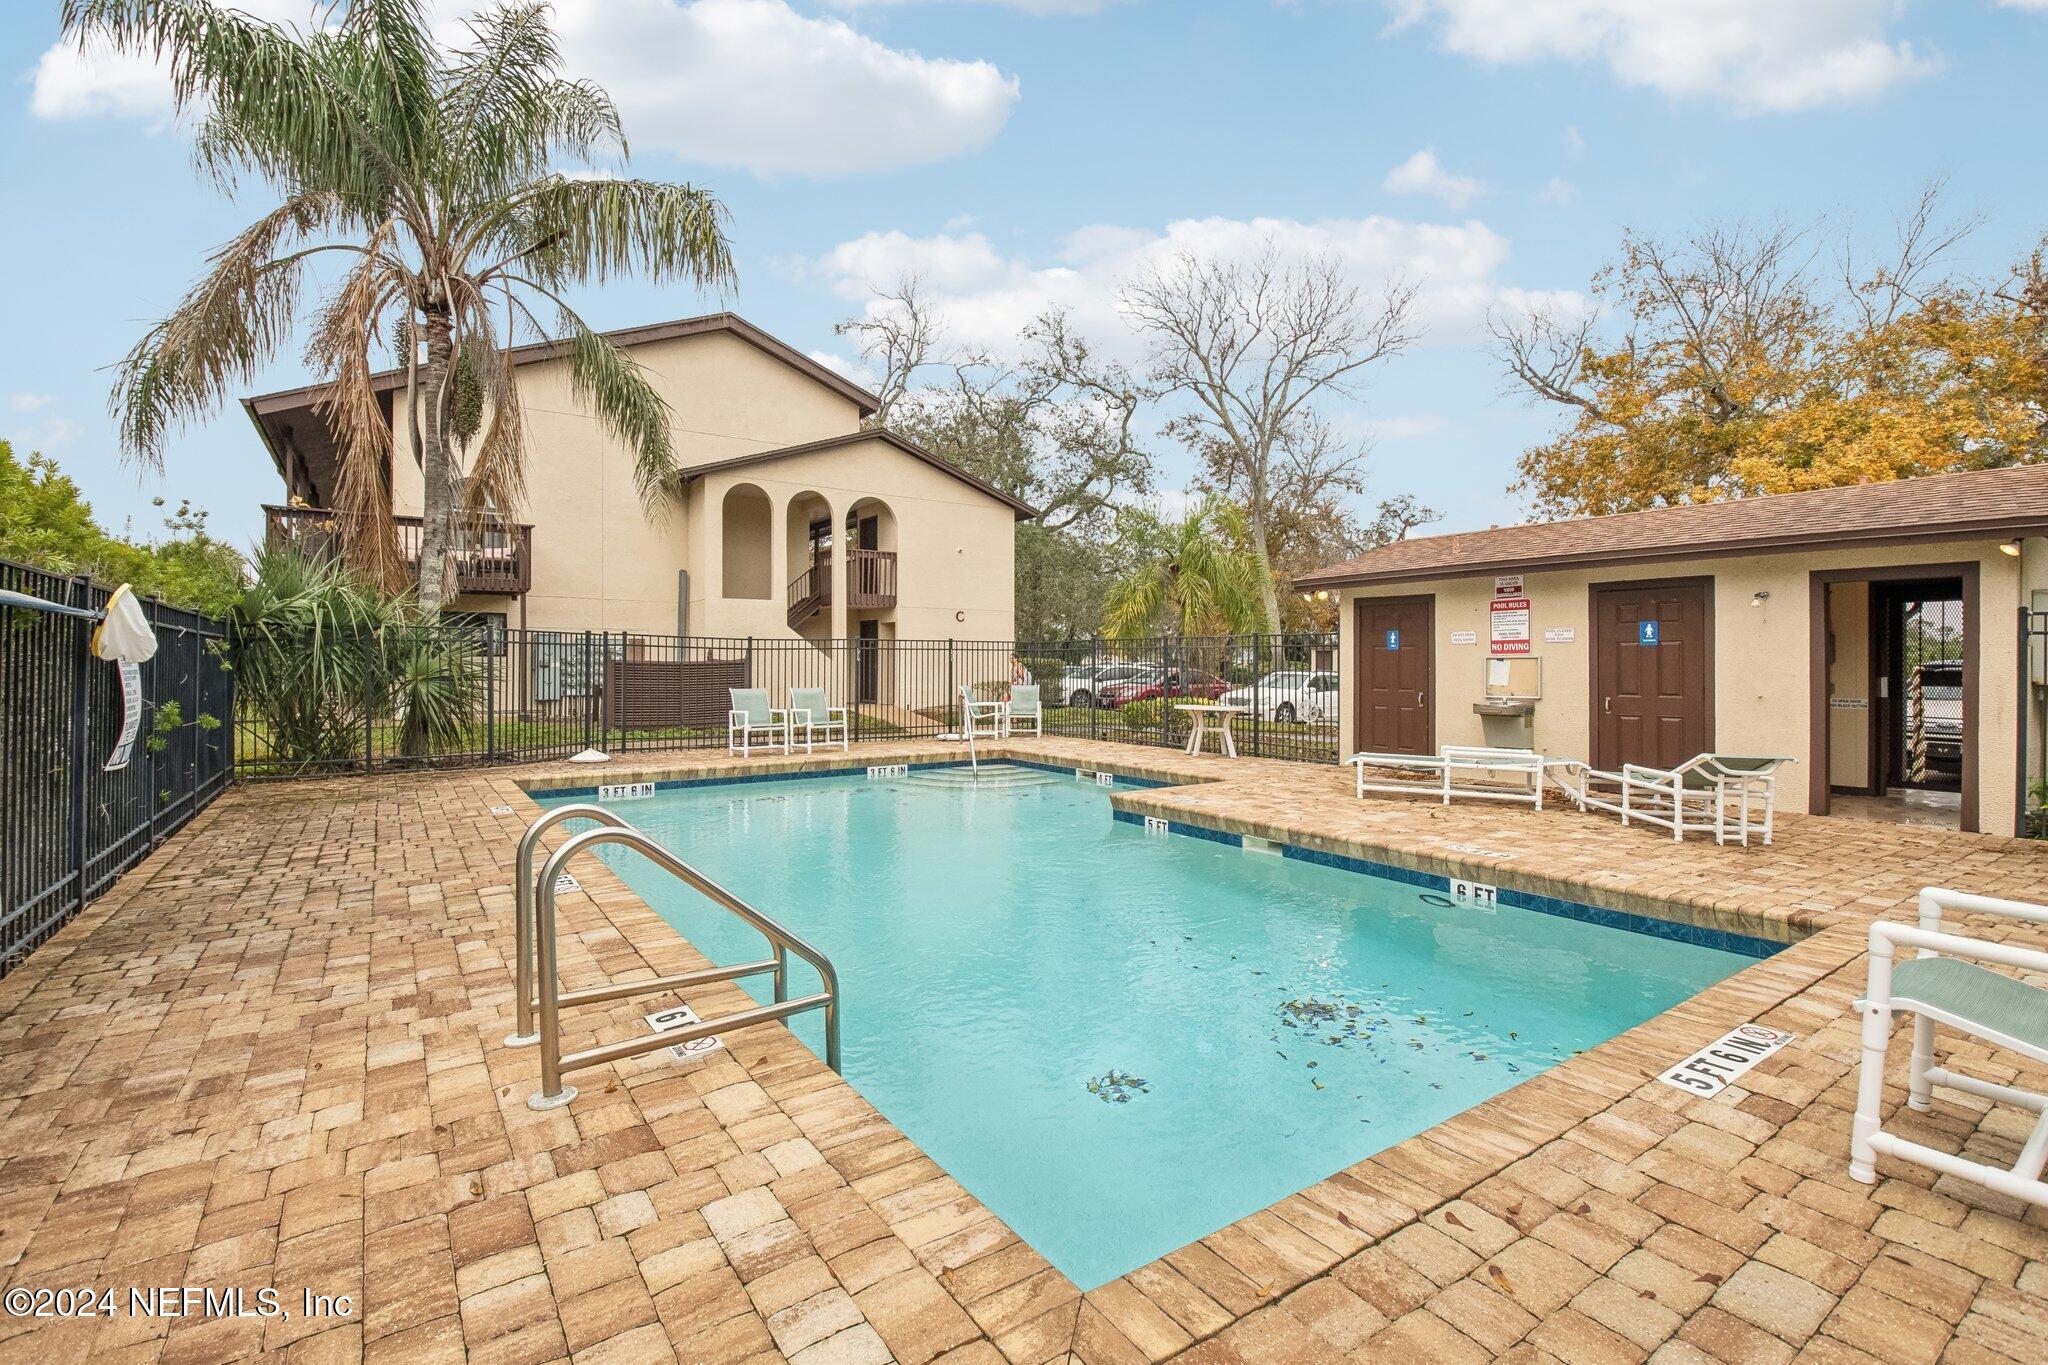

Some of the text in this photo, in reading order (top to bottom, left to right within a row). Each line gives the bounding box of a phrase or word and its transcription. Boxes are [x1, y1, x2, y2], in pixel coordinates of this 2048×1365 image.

[956, 611, 964, 622] C
[878, 767, 887, 777] FT
[898, 766, 906, 776] IN
[603, 784, 652, 798] 3 FT 6 IN
[1148, 819, 1167, 830] 5 FT
[1457, 884, 1494, 903] 6 FT
[1722, 1036, 1772, 1054] IN
[1710, 1050, 1749, 1064] 6
[1684, 1057, 1734, 1078] FT
[1670, 1073, 1714, 1090] 5
